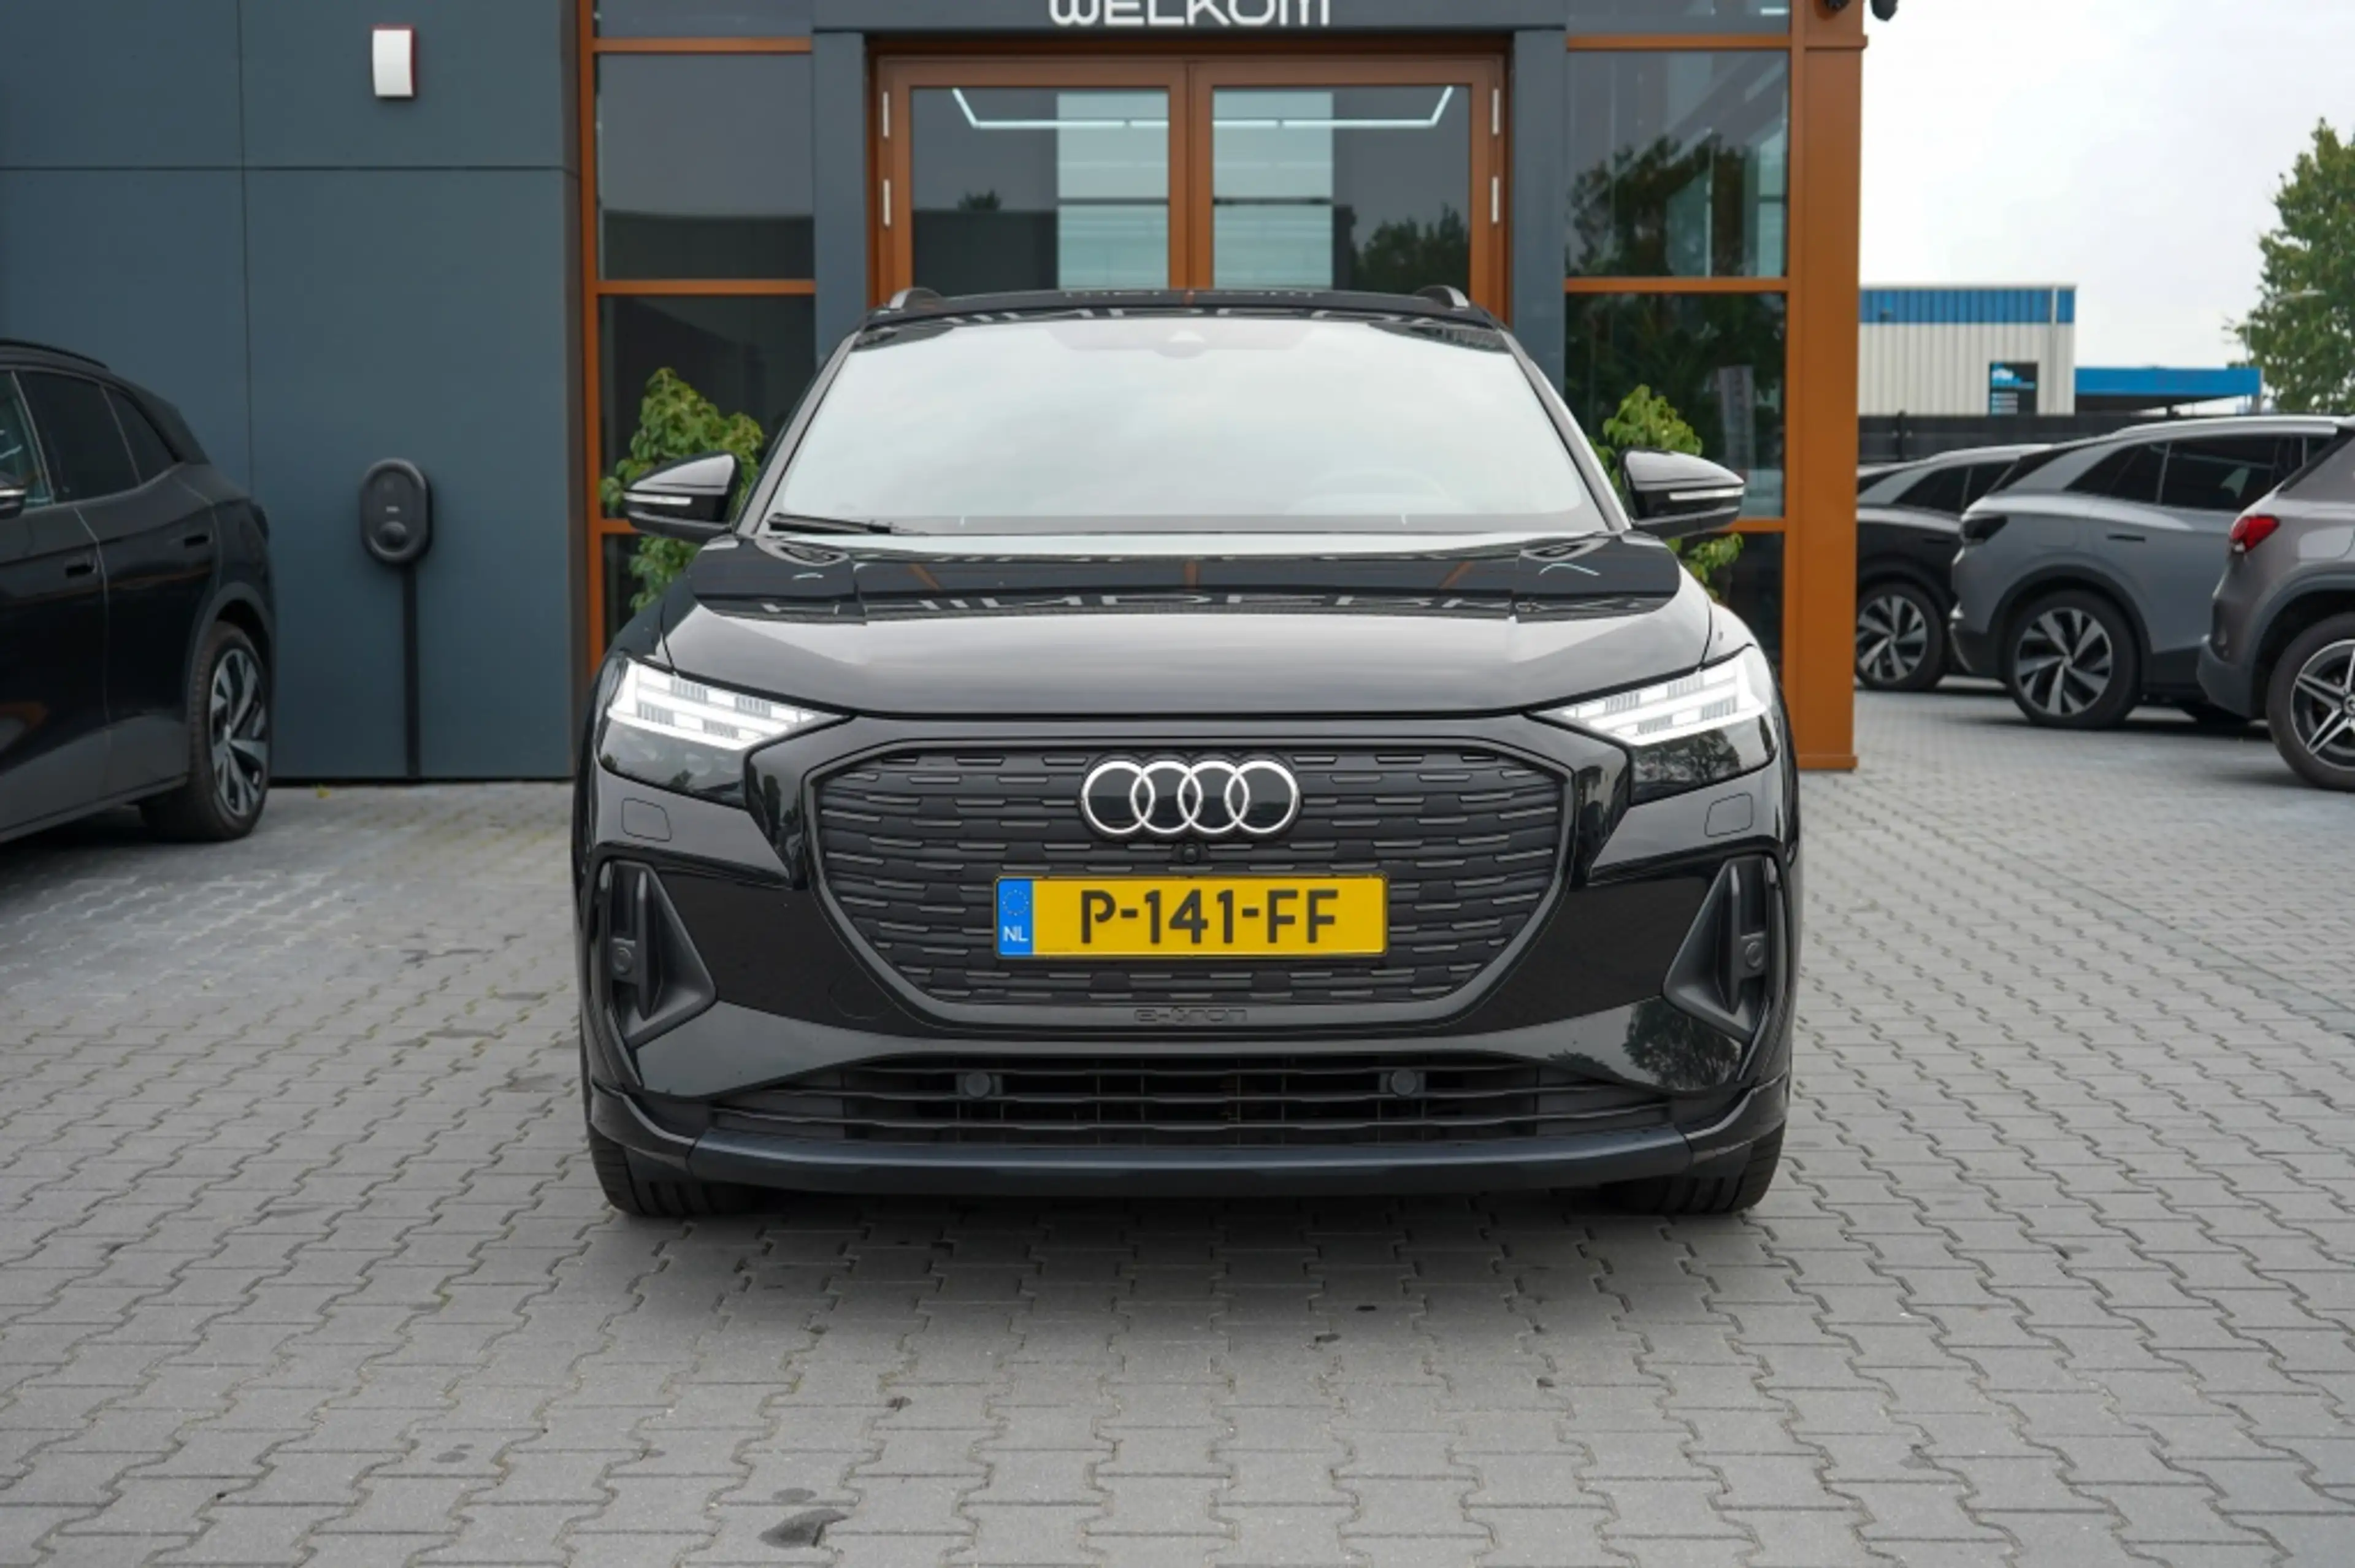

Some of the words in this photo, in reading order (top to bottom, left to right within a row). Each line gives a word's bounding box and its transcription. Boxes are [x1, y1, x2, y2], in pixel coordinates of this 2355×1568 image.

[1049, 0, 1330, 26] WELKOM
[1081, 889, 1338, 944] P-141-FF
[1002, 925, 1029, 943] NL
[1135, 1006, 1247, 1024] e-tron
